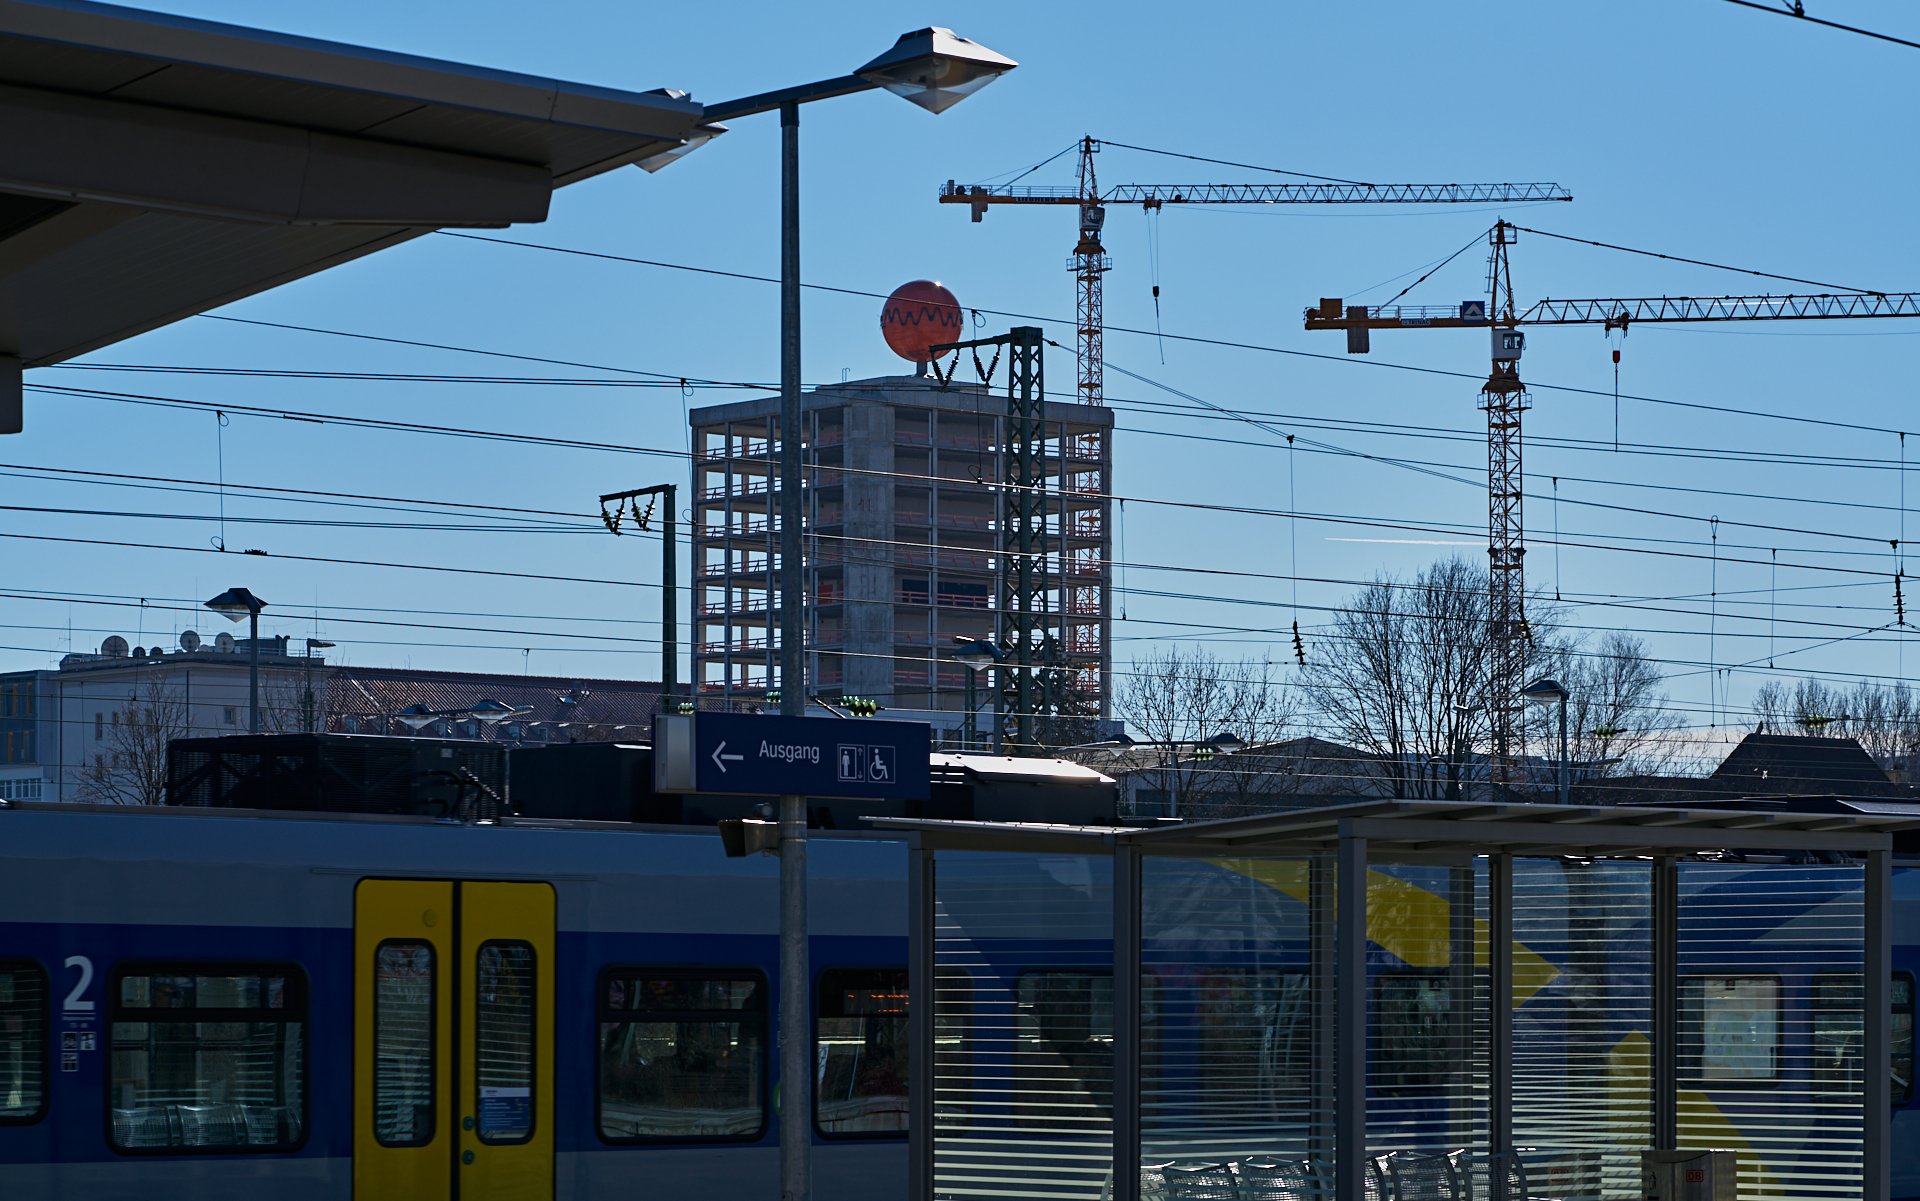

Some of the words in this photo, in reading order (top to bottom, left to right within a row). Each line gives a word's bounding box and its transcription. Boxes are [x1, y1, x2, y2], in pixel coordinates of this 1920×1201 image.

[759, 739, 820, 764] Ausgang
[63, 955, 95, 1010] 2
[1687, 1171, 1702, 1181] DB
